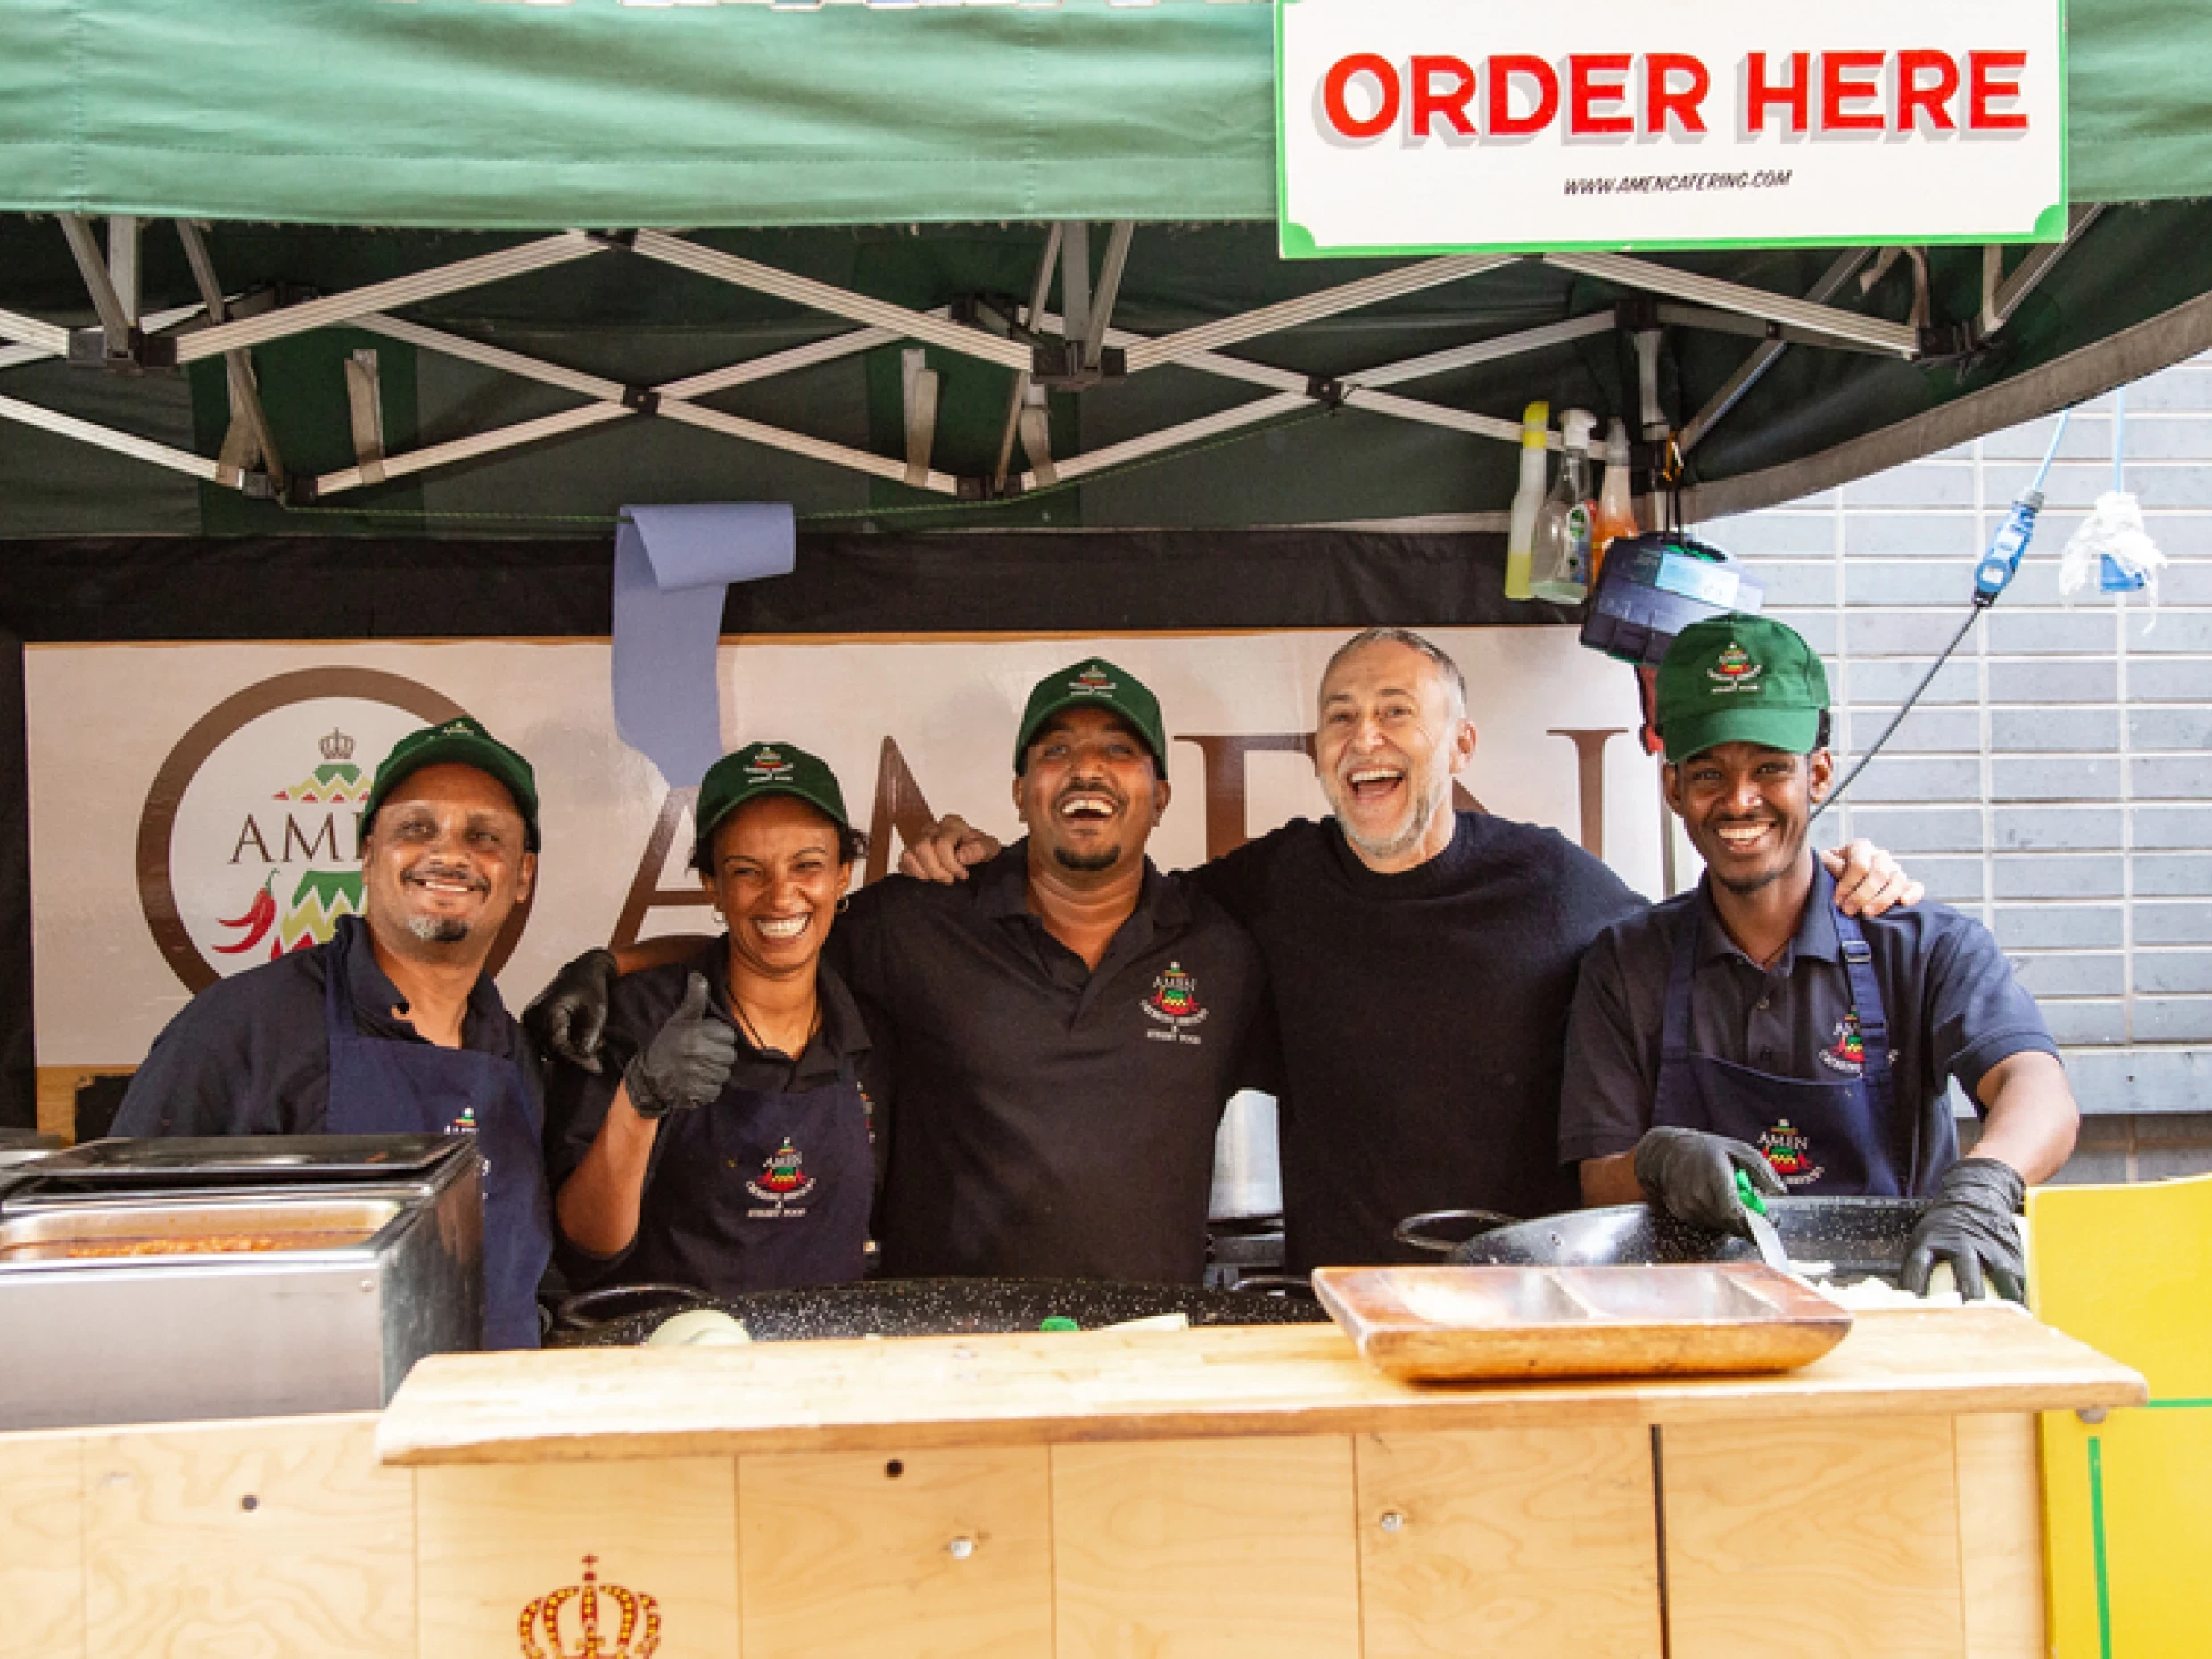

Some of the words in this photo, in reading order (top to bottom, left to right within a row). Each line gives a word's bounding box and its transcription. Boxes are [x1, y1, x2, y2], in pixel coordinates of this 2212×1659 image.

[1317, 51, 1711, 143] ORDER
[1741, 49, 2030, 139] HERE
[1563, 169, 1793, 196] WWW.AMENCATERING.COM
